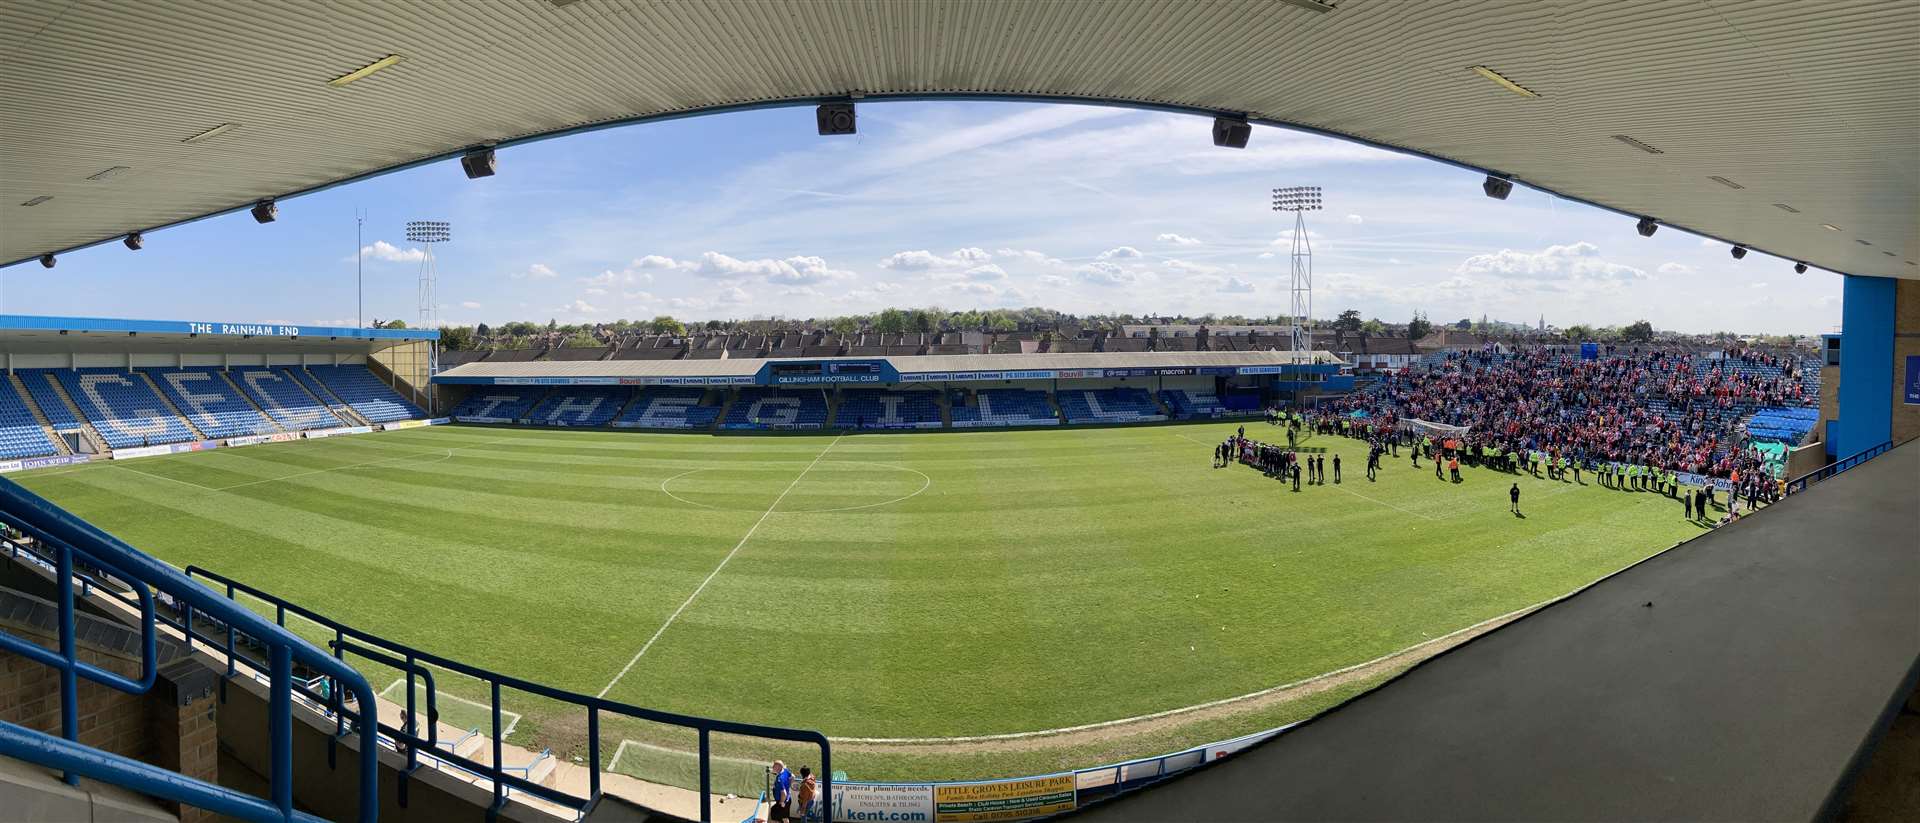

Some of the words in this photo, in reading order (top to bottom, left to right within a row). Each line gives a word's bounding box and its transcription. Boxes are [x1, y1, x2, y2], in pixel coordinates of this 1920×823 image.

[190, 323, 213, 334] THE
[222, 324, 273, 335] RAINHAM
[280, 326, 299, 336] END
[24, 459, 47, 468] JOHN
[48, 457, 70, 465] WEIR
[845, 784, 871, 792] general
[873, 784, 907, 793] plumbing
[938, 787, 970, 796] LITTLE
[972, 783, 1009, 794] GROVES
[1010, 780, 1046, 792] LEISURE
[1049, 775, 1072, 787] PARK
[847, 808, 926, 821] kent.com
